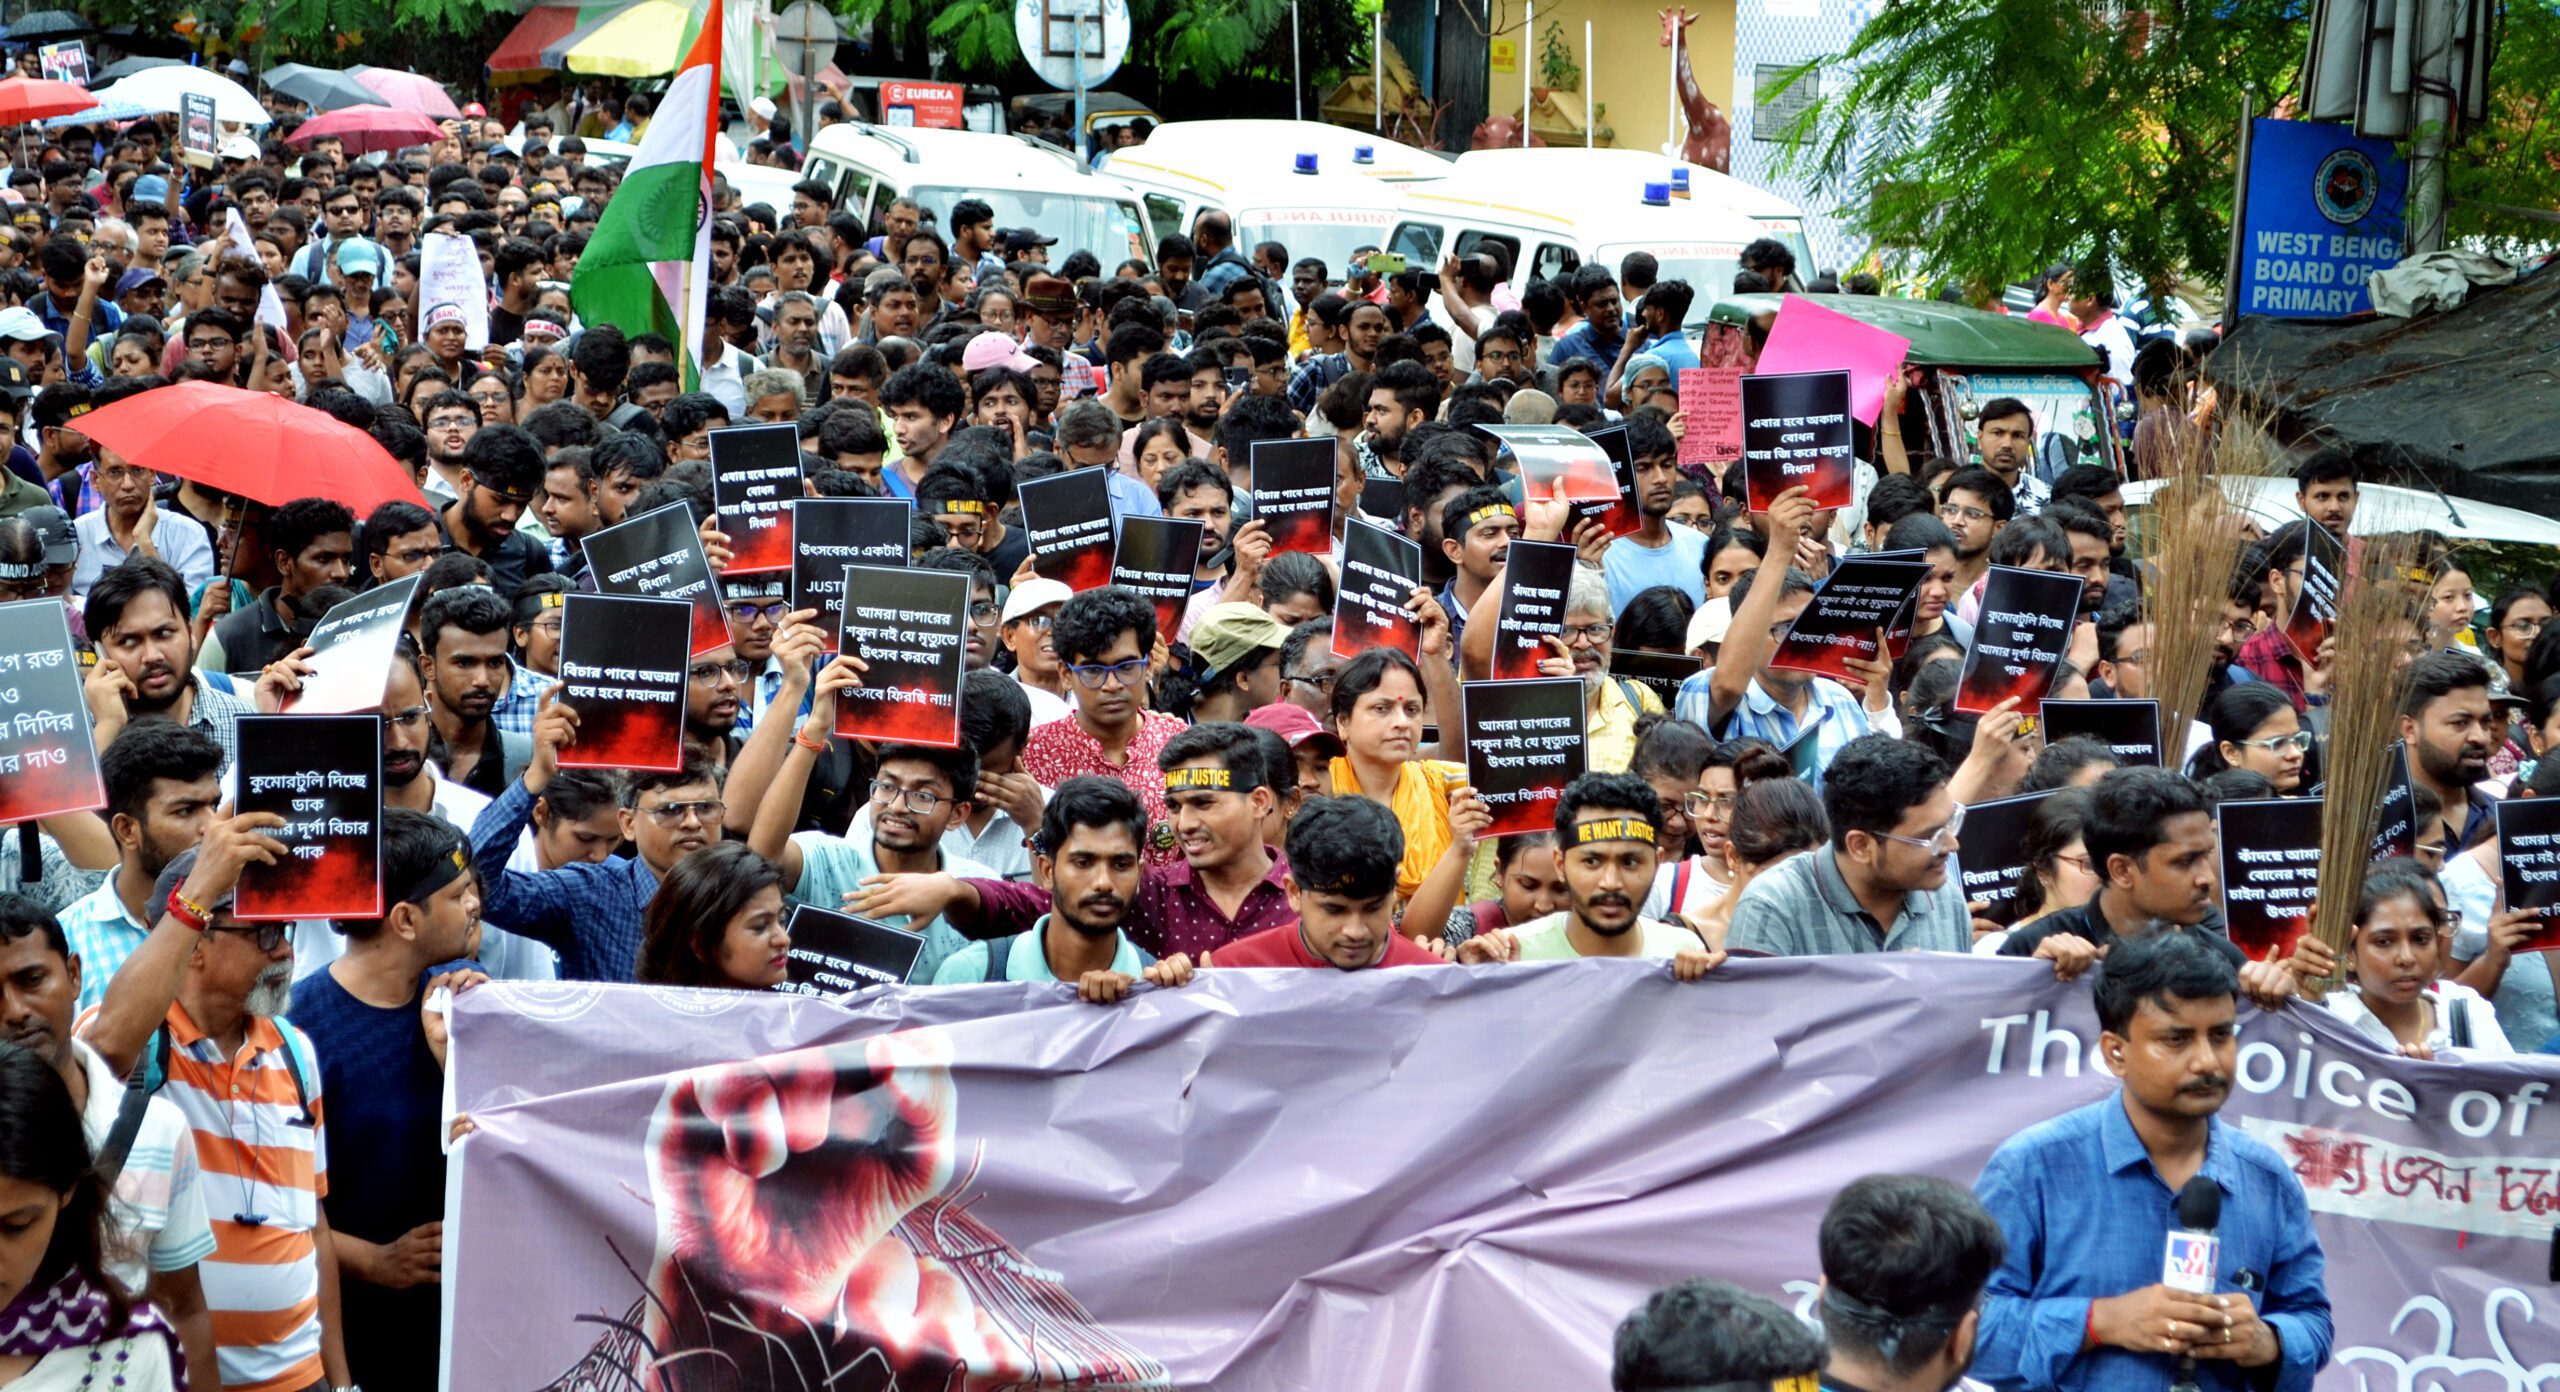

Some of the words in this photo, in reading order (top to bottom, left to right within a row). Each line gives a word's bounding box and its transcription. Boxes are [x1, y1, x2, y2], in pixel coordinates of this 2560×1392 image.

[906, 89, 954, 100] EUREKA
[2257, 231, 2323, 256] WEST
[2330, 235, 2404, 260] BENGA
[2255, 258, 2335, 284] BOARD
[2342, 263, 2373, 286] OF
[2252, 285, 2358, 312] PRIMARY
[1750, 418, 1781, 428] এবার
[1783, 417, 1804, 427] হবে
[1806, 414, 1844, 425] অকাল
[1781, 432, 1815, 443] বোধন
[1747, 450, 1772, 460] আর
[1773, 447, 1791, 460] জি
[1793, 448, 1818, 458] করে
[1820, 445, 1849, 458] অসুর
[1782, 462, 1815, 475] নিধন!
[746, 484, 776, 497] বোধন
[1254, 489, 1280, 500] বিচার
[1281, 488, 1302, 499] পাবে
[1029, 529, 1057, 543] বিচার
[1057, 522, 1080, 536] পাবে
[799, 541, 859, 557] উৎসবেরও
[861, 543, 904, 558] একটাই
[1036, 543, 1057, 555] তবে
[1057, 538, 1074, 551] হবে
[608, 565, 639, 584] আগে
[639, 559, 659, 574] হক
[659, 549, 689, 565] অসুর
[1114, 566, 1143, 580] বিচার
[1144, 570, 1165, 582] পাবে
[726, 583, 739, 599] WE
[806, 580, 845, 593] JUSTI
[1137, 586, 1155, 596] হবে
[856, 606, 896, 620] আমরা
[899, 610, 952, 626] ভাগারের
[1988, 610, 2037, 628] কুমোরটুলি
[845, 625, 877, 642] শকুন
[879, 626, 898, 643] নই
[900, 631, 916, 644] যে
[2012, 631, 2035, 643] ডাক
[24, 649, 63, 669] রক্ত
[859, 644, 899, 662] উৎসব
[900, 651, 941, 665] করবো
[1978, 643, 2010, 658] আমার
[2031, 649, 2057, 662] বিচার
[563, 661, 601, 679] বিচার
[604, 666, 636, 681] পাবে
[639, 670, 680, 683] অভয়া
[2004, 665, 2027, 677] পাক
[568, 685, 596, 698] তবে
[598, 686, 622, 700] হবে
[626, 689, 676, 703] মহালয়া
[842, 686, 885, 700] উৎসবে
[887, 686, 927, 704] ফিরছি
[929, 694, 952, 706] না!!
[14, 710, 74, 737] দিদির
[1478, 719, 1518, 732] আমরা
[1520, 717, 1571, 731] ভাগারের
[1470, 738, 1502, 753] শকুন
[1504, 735, 1522, 749] নই
[1524, 736, 1539, 749] যে
[2111, 744, 2153, 755] অকাল
[25, 748, 68, 769] দাও
[1487, 754, 1525, 768] উৎসব
[1527, 753, 1566, 766] করবো
[249, 771, 325, 793] কুমোরটুলি
[327, 770, 367, 788] দিচ্ছে
[1166, 769, 1189, 788] WANT
[1190, 768, 1231, 787] JUSTICE
[1518, 786, 1558, 802] ফিরছি
[291, 798, 325, 812] ডাক
[328, 817, 369, 836] বিচার
[1578, 823, 1592, 843] WE
[1592, 820, 1623, 839] WANT
[1625, 820, 1655, 843] JUSTICE
[2386, 820, 2407, 841] FOR
[2511, 834, 2549, 846] আমরা
[293, 845, 325, 860] পাক
[2238, 848, 2283, 863] কাঁদছে
[2504, 853, 2535, 868] শকুন
[2537, 850, 2554, 864] নই
[1963, 870, 2000, 887] বিচার
[2248, 869, 2293, 881] বোনের
[2295, 868, 2317, 880] শব
[2521, 869, 2558, 882] উৎসব
[1971, 889, 1999, 902] তবে
[2228, 885, 2265, 900] চাইনা
[2267, 887, 2299, 900] এমন
[2266, 904, 2307, 918] উৎসব
[787, 948, 823, 965] এবার
[824, 955, 851, 972] হবে
[851, 964, 898, 984] অকাল
[814, 971, 857, 990] বোধন
[2234, 1028, 2418, 1122] oice
[2449, 1082, 2550, 1138] of
[2381, 1151, 2478, 1204] ভবন
